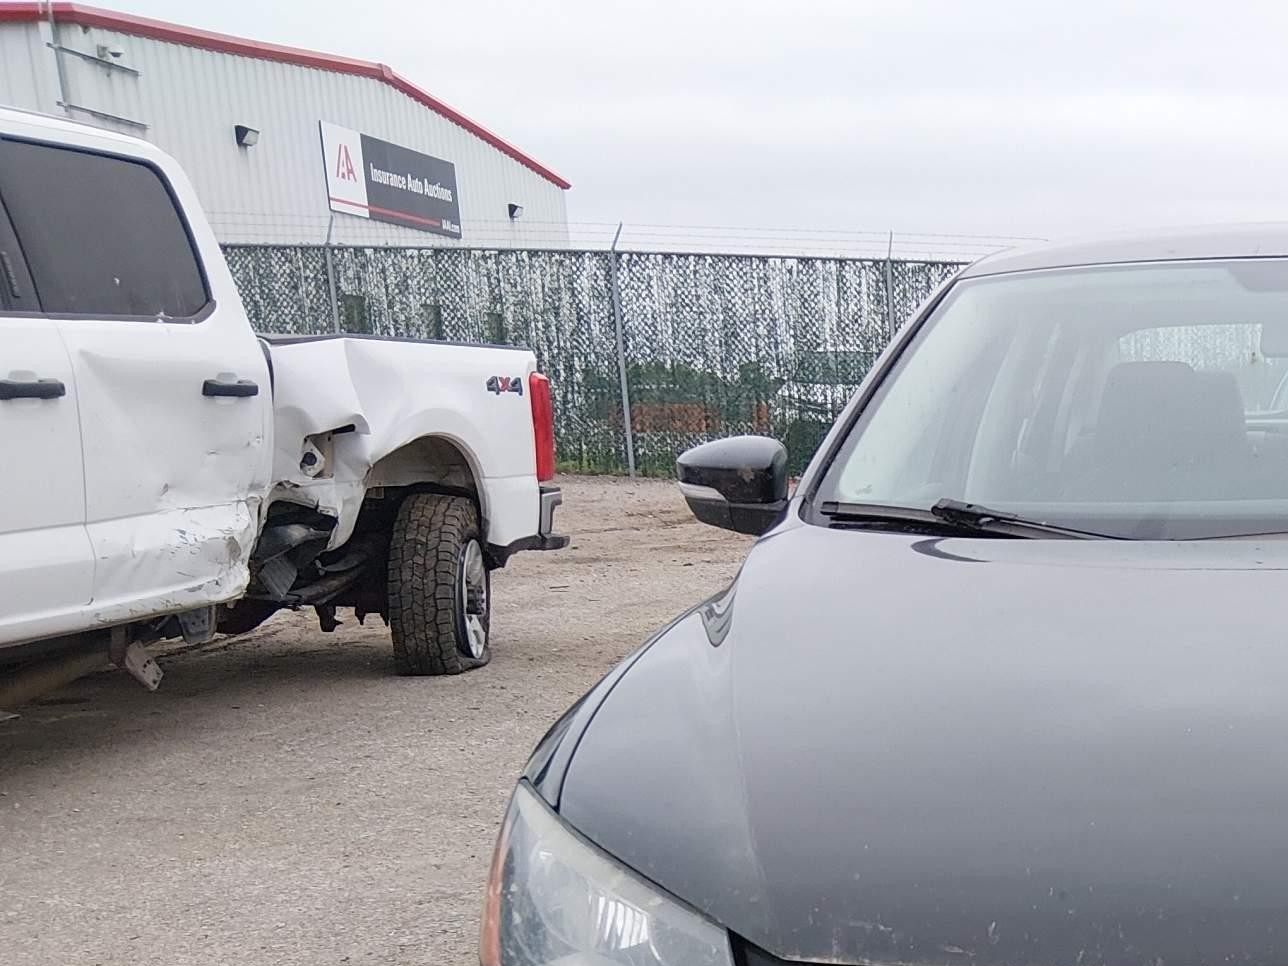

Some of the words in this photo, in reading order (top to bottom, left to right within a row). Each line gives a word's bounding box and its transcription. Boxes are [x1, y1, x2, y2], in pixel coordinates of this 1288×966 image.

[369, 162, 407, 190] Insurance
[407, 173, 424, 195] Auto
[424, 178, 453, 203] Auctions
